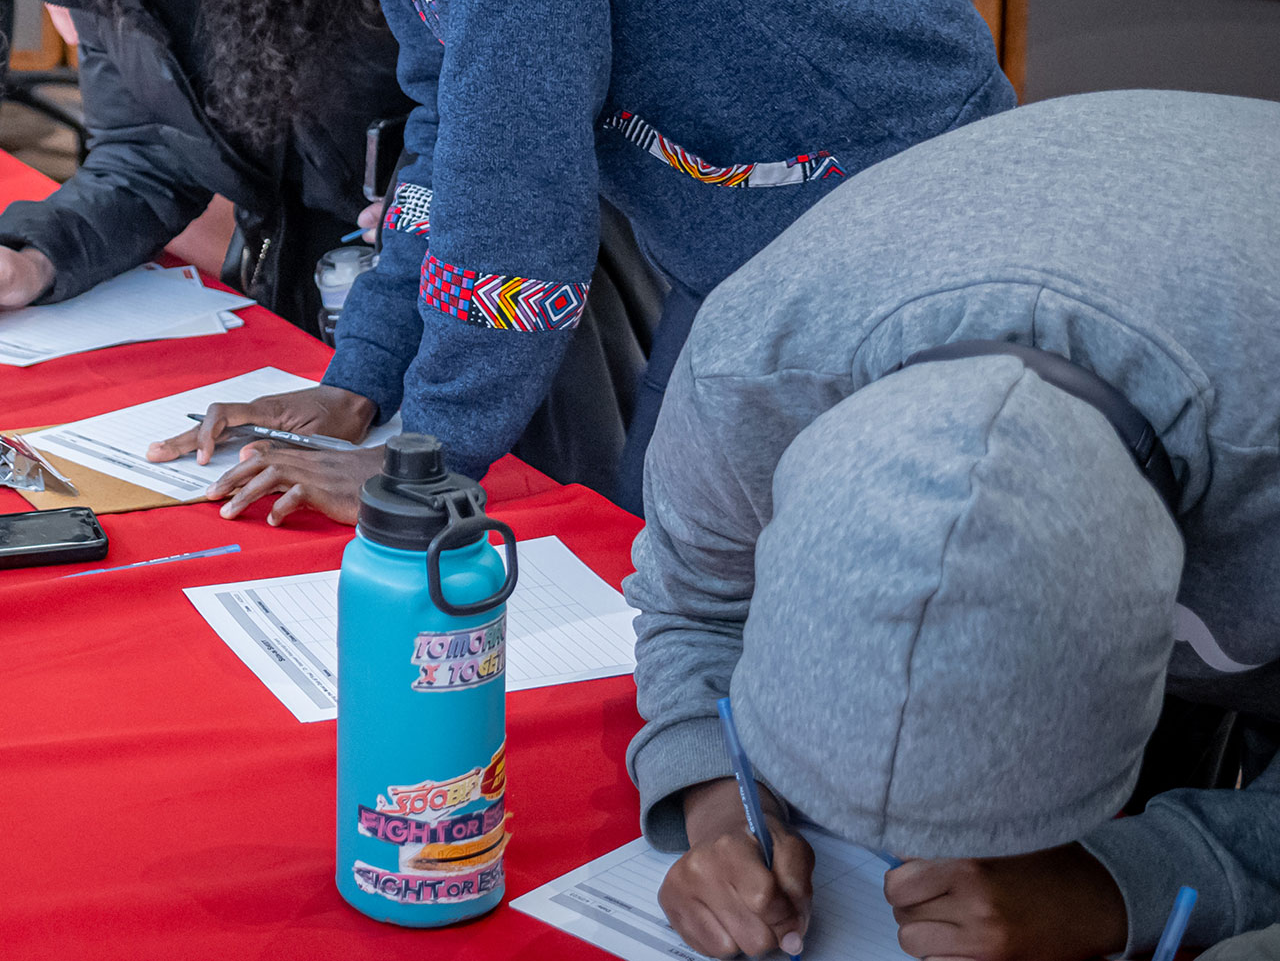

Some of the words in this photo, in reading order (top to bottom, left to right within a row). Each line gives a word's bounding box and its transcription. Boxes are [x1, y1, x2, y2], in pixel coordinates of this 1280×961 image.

[416, 620, 506, 659] TOMORR
[417, 663, 441, 686] X
[449, 646, 506, 685] TOGET
[360, 809, 451, 844] FIGHT
[452, 819, 479, 837] OR
[447, 880, 475, 898] OR
